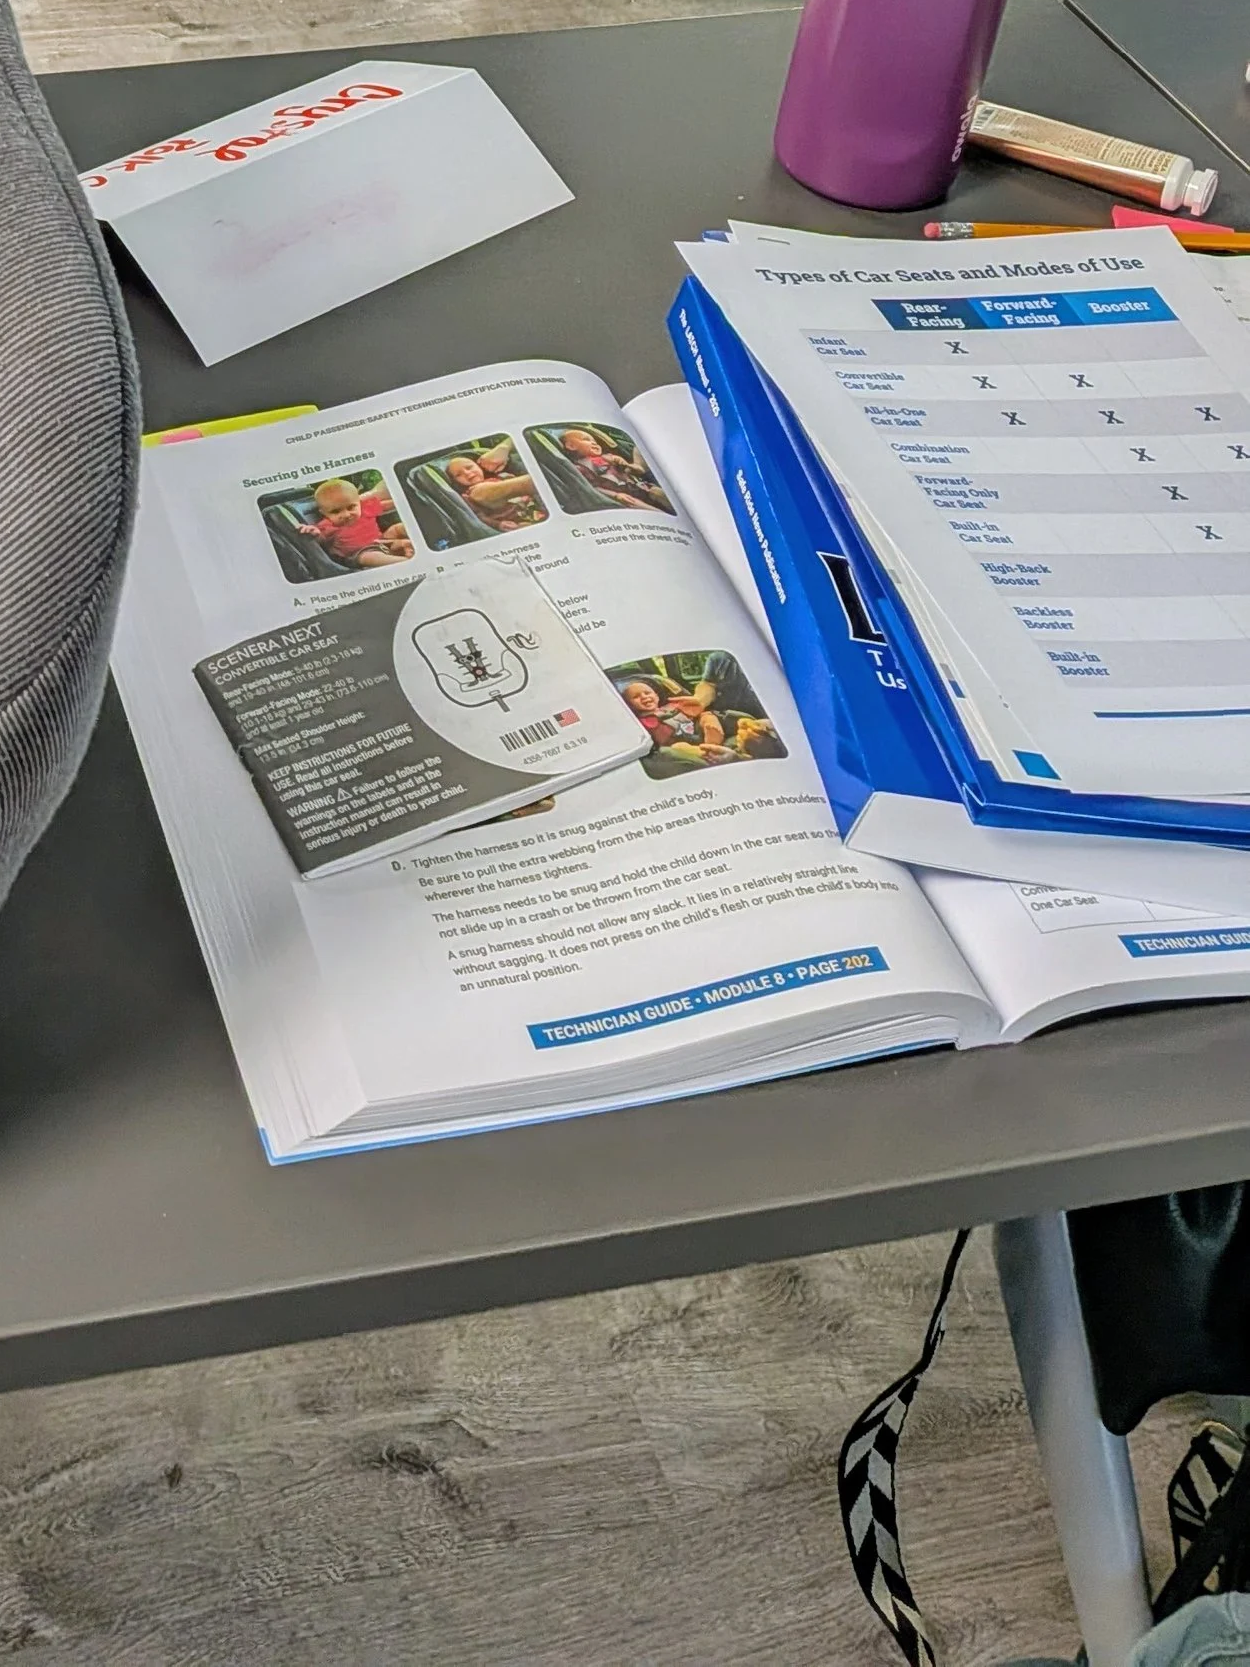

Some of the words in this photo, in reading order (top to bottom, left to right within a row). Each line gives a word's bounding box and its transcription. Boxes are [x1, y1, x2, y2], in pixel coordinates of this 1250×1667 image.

[196, 82, 406, 163] Crystal
[754, 268, 826, 286] Types
[829, 268, 851, 283] of
[853, 269, 894, 284] Car
[898, 266, 955, 283] Seats
[959, 264, 999, 280] and
[1001, 262, 1074, 279] Modes
[1077, 258, 1101, 274] of
[1099, 256, 1145, 272] Use
[900, 301, 948, 315] Rear-
[979, 297, 1058, 312] Forward-
[1088, 299, 1151, 314] Booster
[907, 314, 966, 329] Facing
[1001, 311, 1061, 327] Facing
[809, 336, 848, 346] Infant
[944, 341, 969, 354] X
[816, 347, 839, 356] Car
[840, 347, 867, 356] Seat
[835, 370, 905, 381] Convertible
[972, 376, 997, 389] X
[1068, 374, 1094, 388] X
[843, 381, 866, 390] Car
[867, 381, 894, 391] Seat
[285, 432, 312, 445] CHILD
[456, 377, 524, 400] CERTIFICATION
[863, 405, 927, 417] All-in-One
[1000, 411, 1027, 425] X
[1098, 410, 1124, 424] X
[1194, 406, 1221, 421] X
[870, 417, 894, 426] Car
[895, 417, 923, 427] Seat
[890, 442, 970, 454] Combination
[1129, 448, 1156, 462] X
[1227, 445, 1250, 460] X
[899, 454, 921, 463] Car
[923, 454, 952, 464] Seat
[242, 468, 299, 489] Securing
[299, 462, 322, 477] the
[322, 450, 376, 471] Harness
[914, 475, 973, 486] Forward-
[923, 487, 969, 499] Facing
[969, 488, 1000, 500] Only
[1161, 486, 1189, 500] X
[933, 499, 957, 508] Car
[958, 499, 987, 509] Seat
[949, 520, 1000, 532] Built-in
[1196, 525, 1223, 540] X
[958, 533, 982, 543] Car
[985, 534, 1014, 544] Seat
[980, 562, 1052, 575] High-Back
[990, 575, 1042, 586] Booster
[1012, 606, 1074, 617] Backless
[1022, 619, 1075, 630] Booster
[207, 637, 281, 676] SCENERA
[282, 621, 324, 646] NEXT
[215, 649, 290, 686] CONVERTIBLE
[290, 642, 313, 659] CAR
[313, 635, 340, 652] SEAT
[1047, 651, 1101, 662] Built-in
[1057, 665, 1110, 676] Booster
[876, 671, 907, 690] Us
[267, 765, 292, 783] KEEP
[292, 742, 357, 774] INSTRUCTIONS
[356, 734, 376, 750] FOR
[375, 722, 413, 742] FUTURE
[391, 860, 406, 872] D.
[411, 854, 452, 871] Tighten
[454, 849, 473, 861] the
[474, 840, 519, 857] harness
[521, 837, 535, 847] so
[536, 832, 546, 843] it
[546, 830, 557, 841] is
[559, 825, 587, 840] snug
[588, 813, 628, 832] against
[629, 807, 648, 820] the
[649, 796, 685, 813] child's
[687, 788, 718, 804] body.
[424, 887, 476, 903] wherever
[477, 881, 496, 893] the
[496, 873, 542, 890] harness
[544, 860, 592, 880] tightens.
[1030, 900, 1051, 912] One
[1053, 898, 1073, 908] Car
[1074, 895, 1100, 906] Seat
[1133, 934, 1220, 952] TECHNICIAN
[542, 1011, 643, 1042] TECHNICIAN
[643, 996, 695, 1020] GUIDE
[703, 974, 774, 1005] MODULE
[774, 972, 786, 986] 8
[796, 958, 843, 981] PAGE
[843, 954, 874, 971] 202
